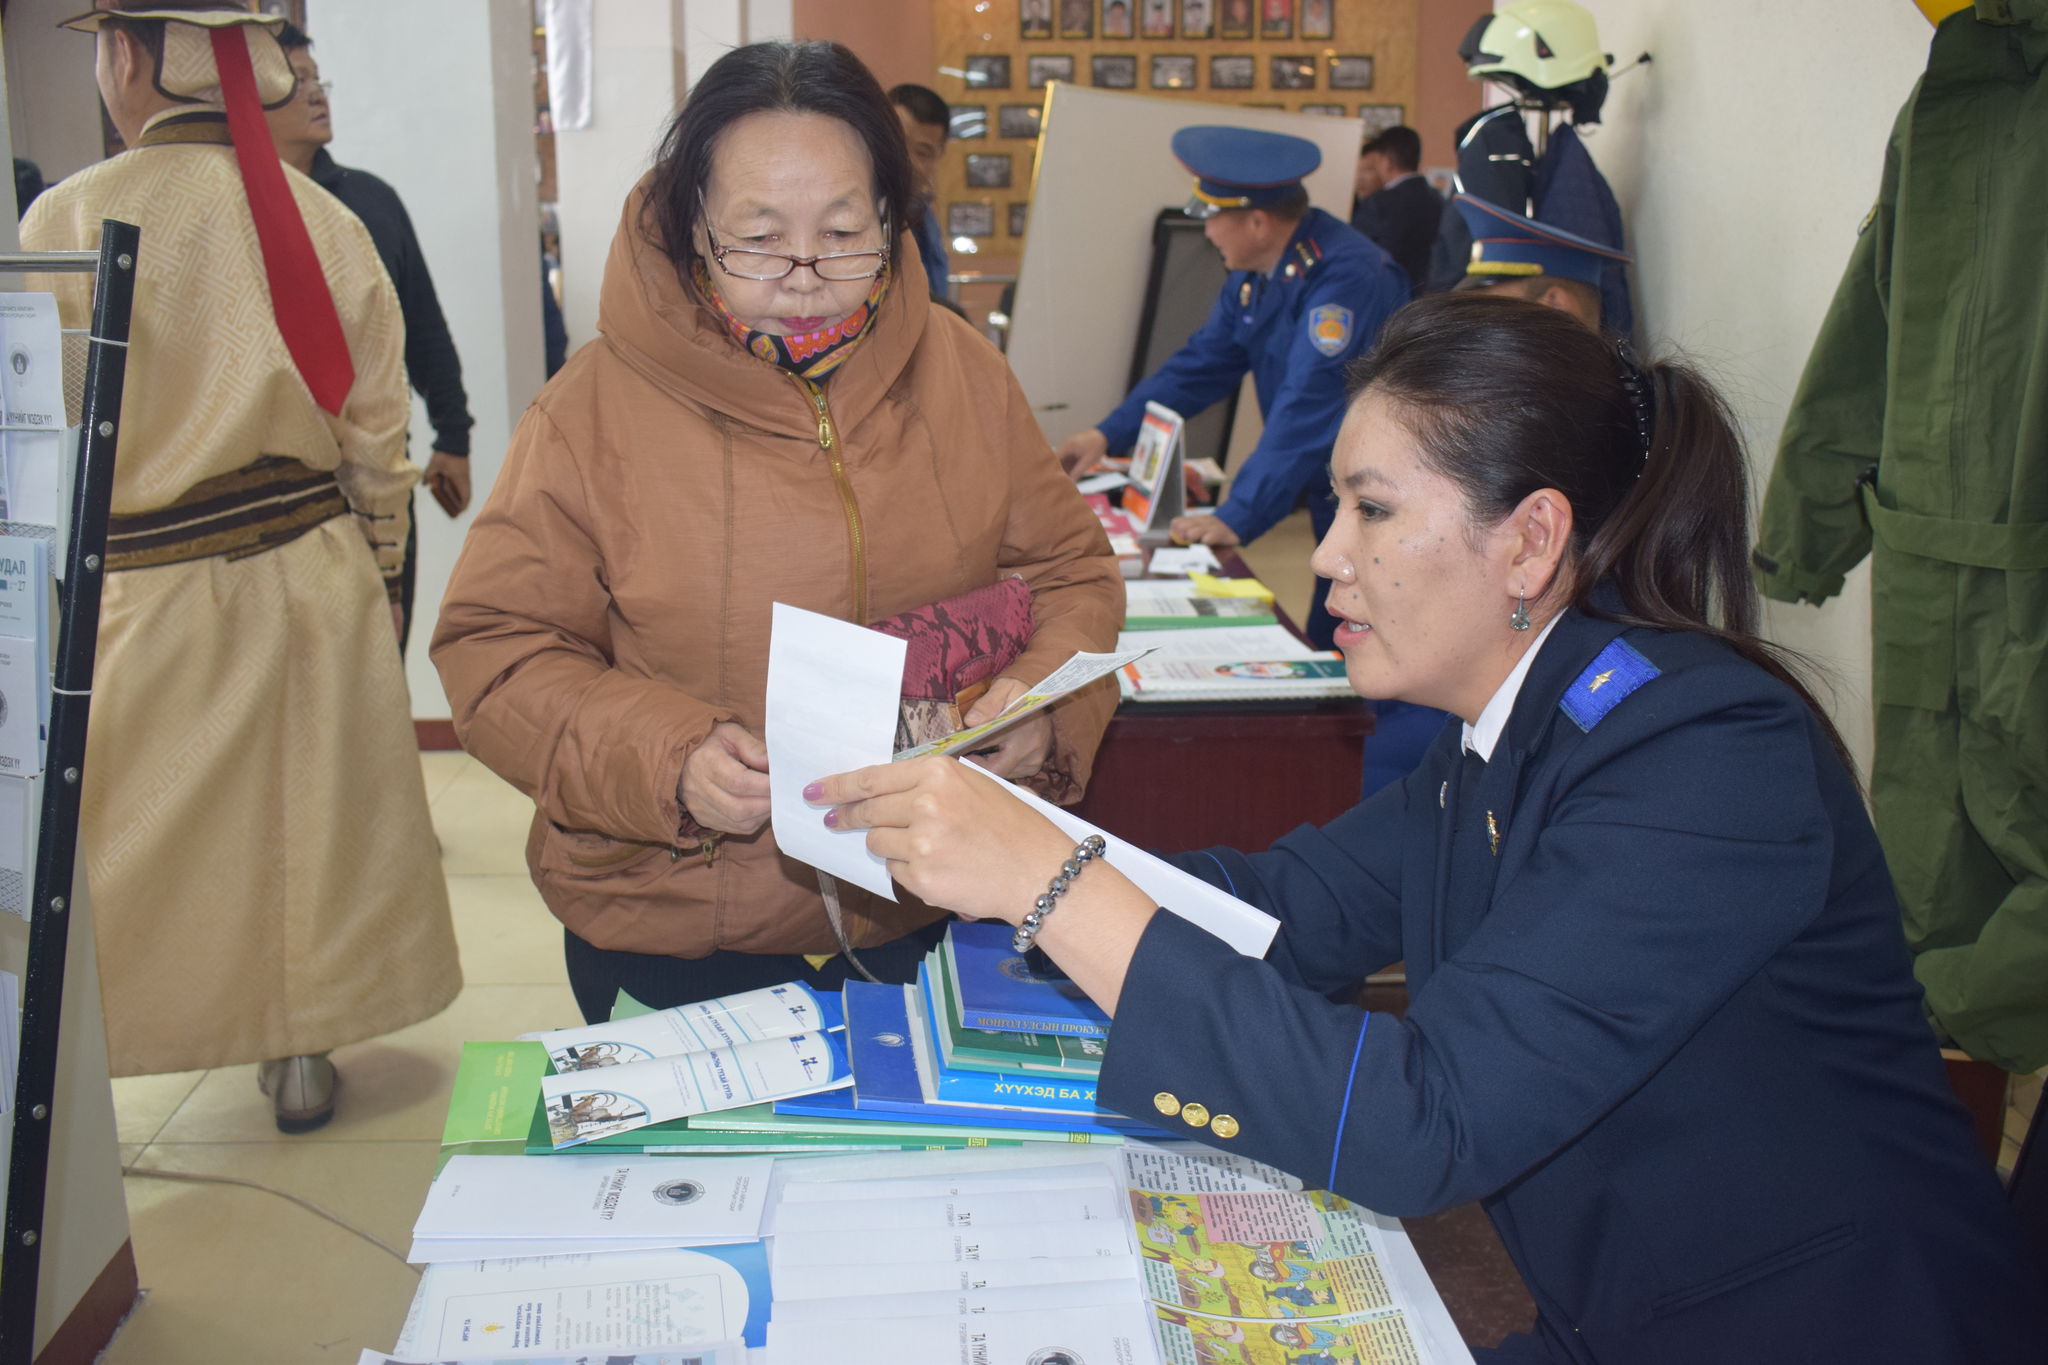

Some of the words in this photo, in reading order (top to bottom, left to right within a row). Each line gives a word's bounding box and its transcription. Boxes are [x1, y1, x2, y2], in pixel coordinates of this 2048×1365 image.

[977, 1017, 1021, 1029] МОНГОЛ
[1023, 1020, 1060, 1032] УЛСЫН
[993, 1082, 1055, 1099] ХҮҮХЭД
[1058, 1089, 1080, 1100] БА
[966, 1244, 979, 1253] ТА
[972, 1333, 986, 1342] ТА
